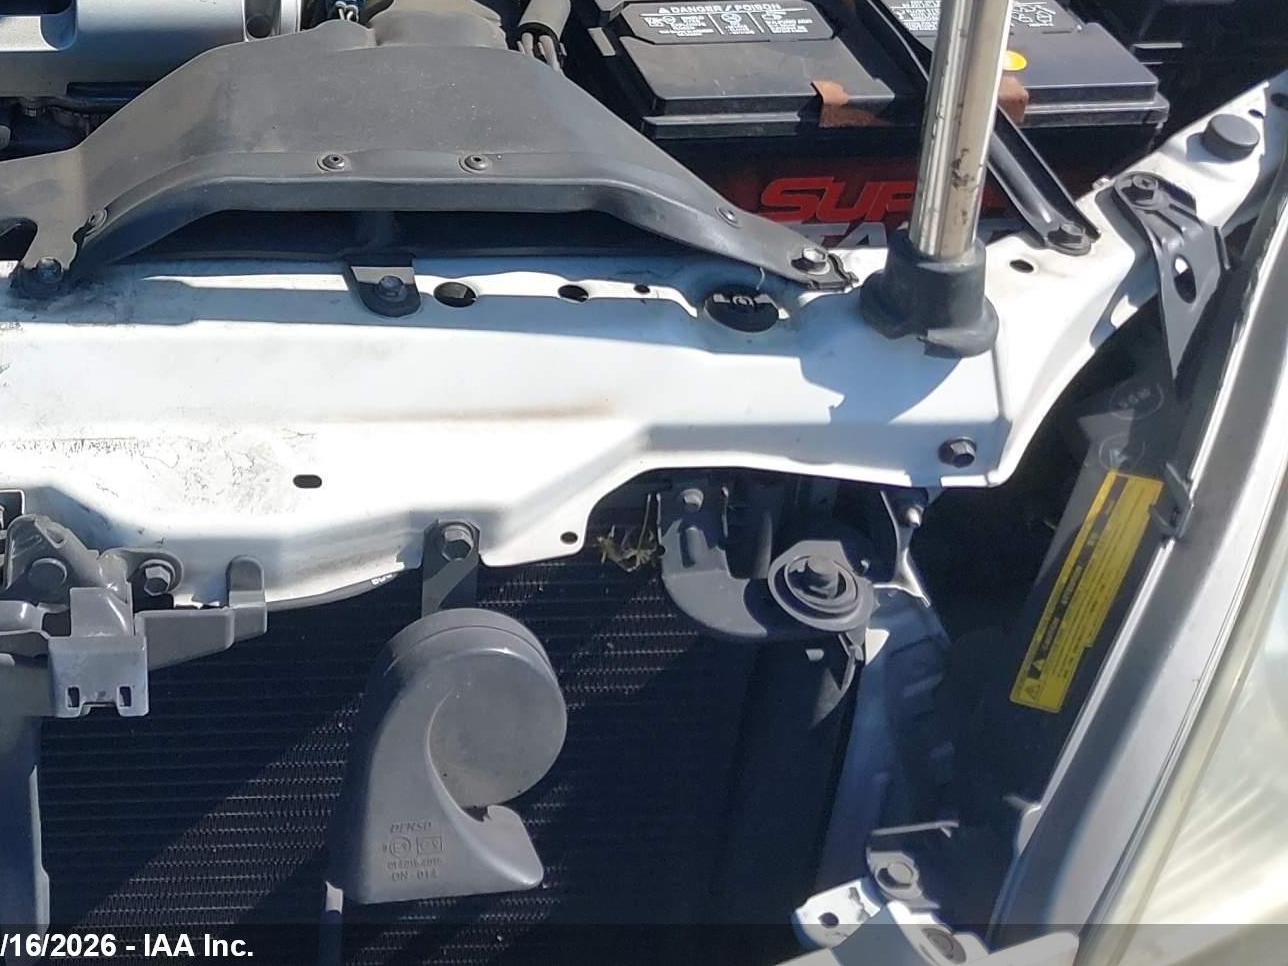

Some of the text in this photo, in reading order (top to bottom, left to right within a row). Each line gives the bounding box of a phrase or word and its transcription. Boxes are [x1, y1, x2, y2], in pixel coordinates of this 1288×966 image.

[670, 5, 723, 14] DANGER
[735, 2, 782, 12] POISON
[761, 176, 918, 222] SUP
